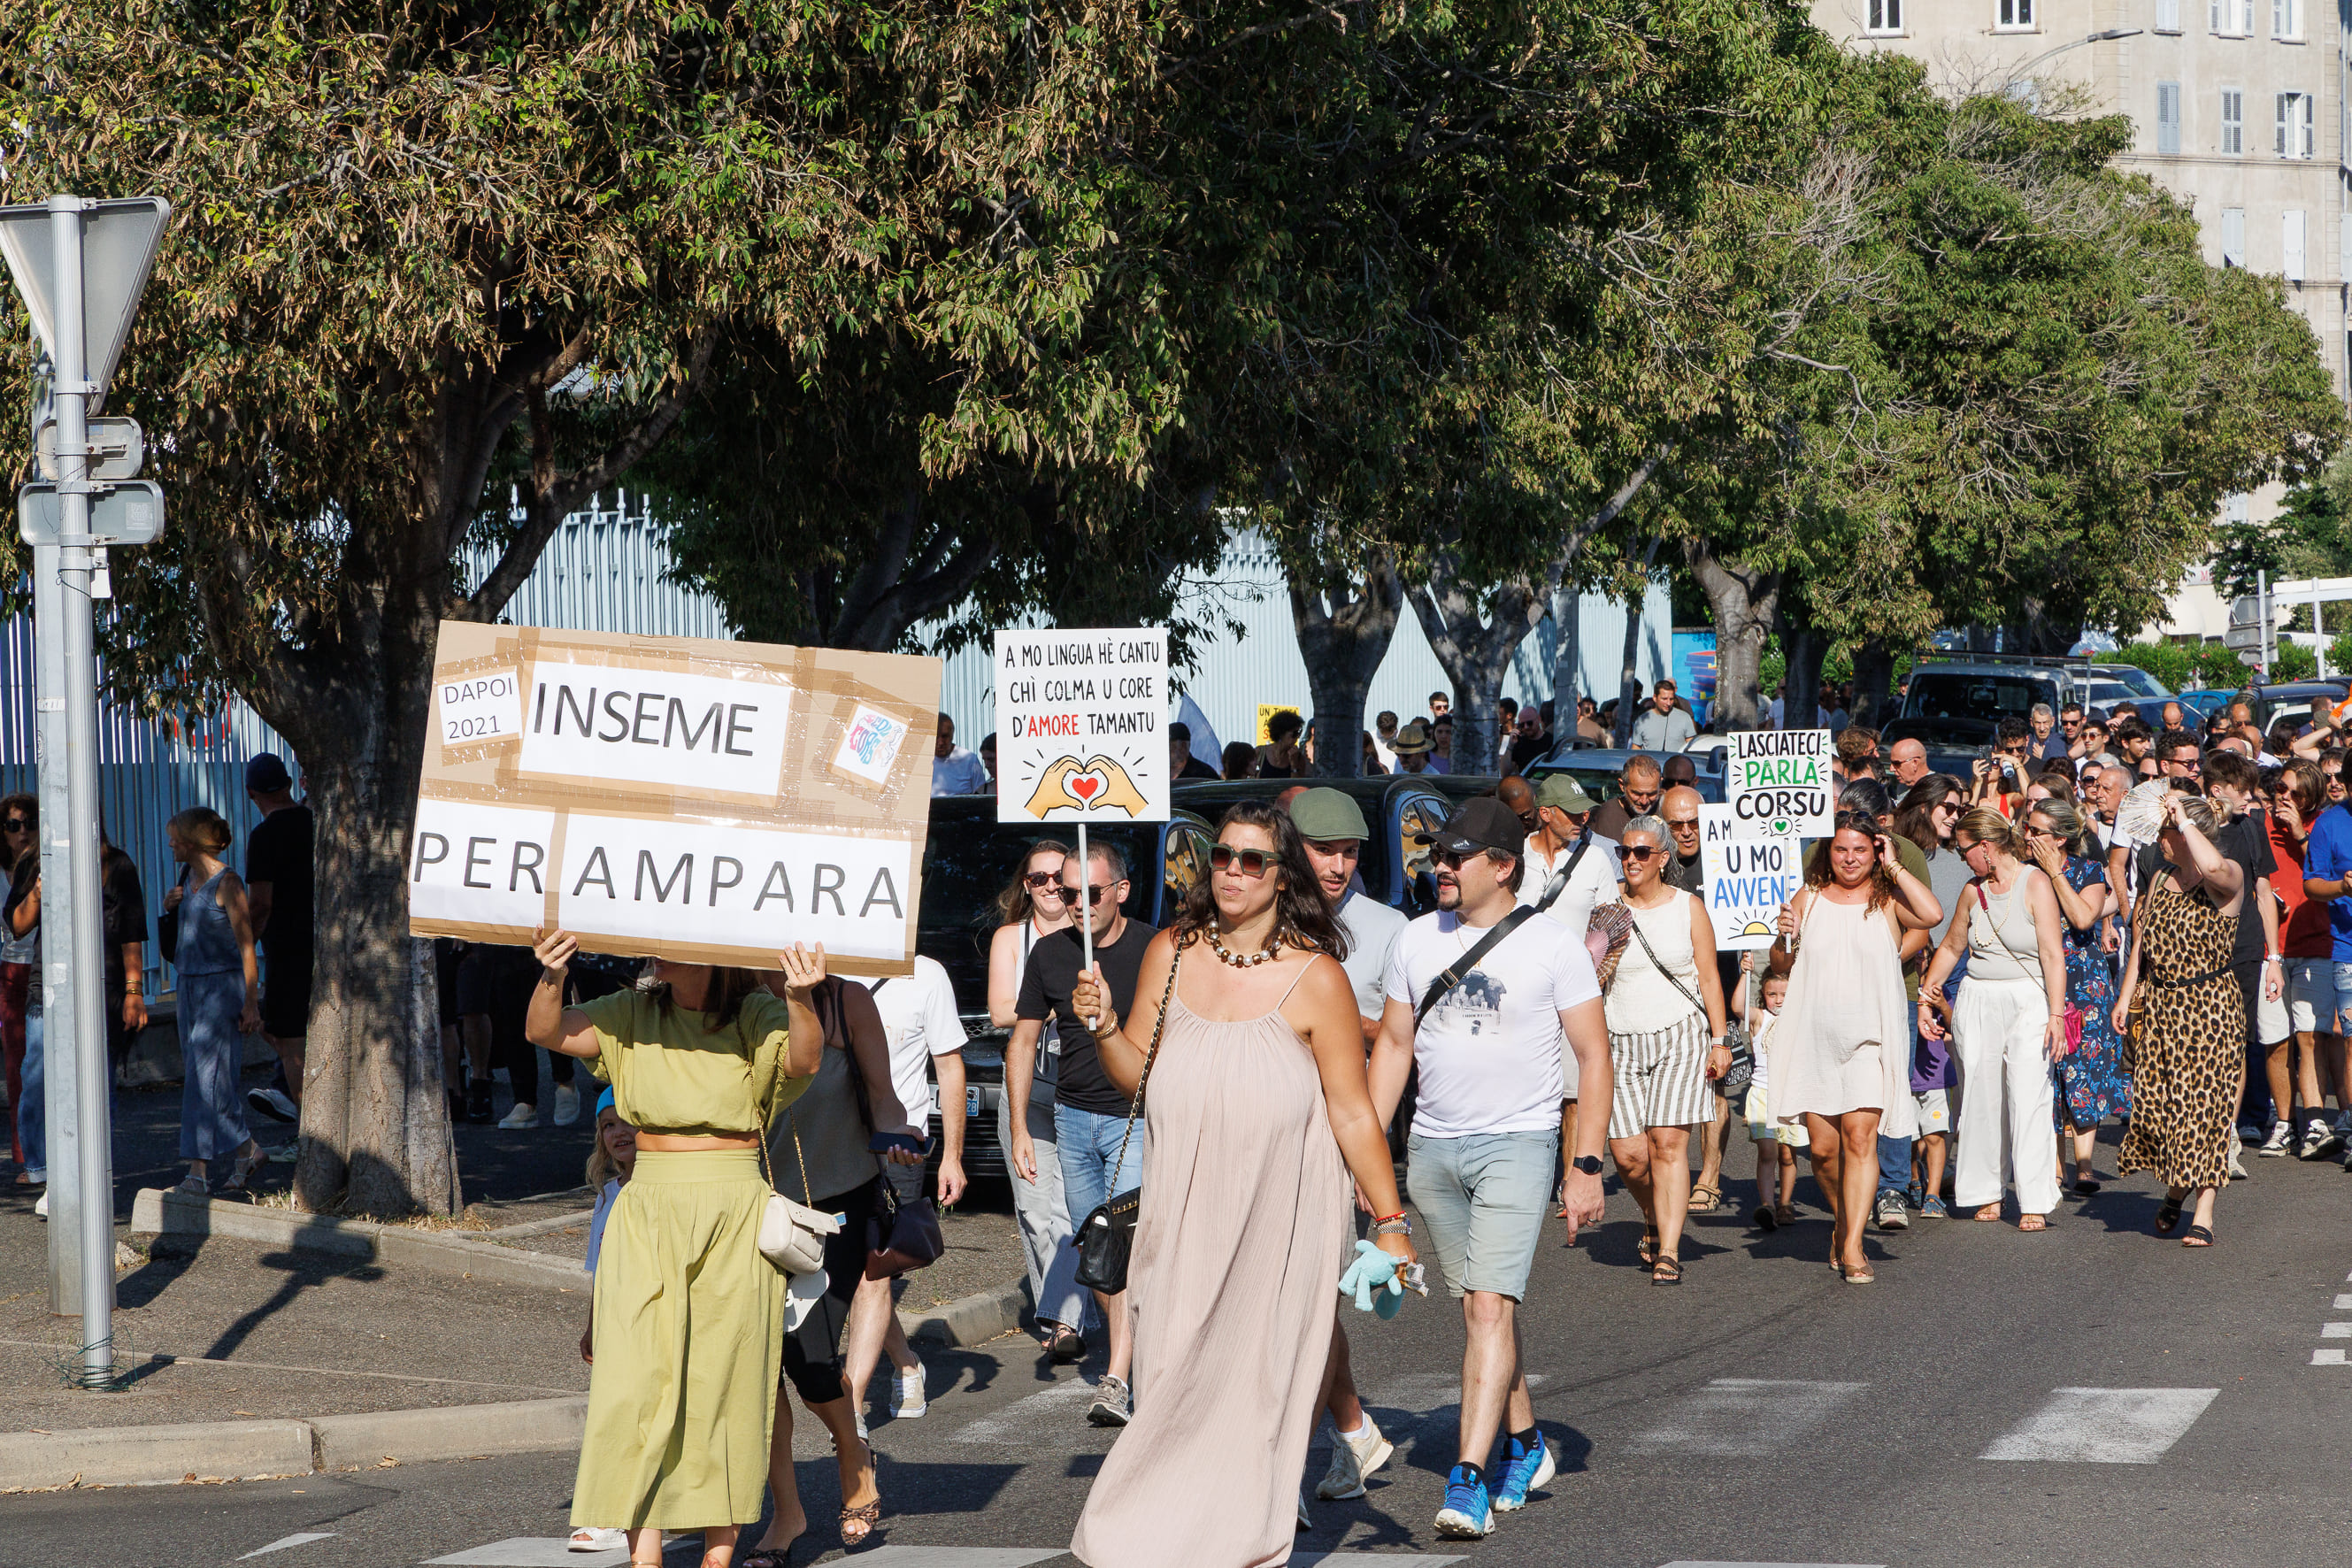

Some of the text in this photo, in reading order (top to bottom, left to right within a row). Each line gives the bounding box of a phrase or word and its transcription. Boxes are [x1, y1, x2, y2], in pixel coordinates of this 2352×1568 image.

[1006, 637, 1158, 668] A MO LINGUA HÈ CANTU
[443, 677, 512, 704] DAPOI
[1010, 676, 1152, 703] CHÌ COLMA U CORE
[449, 716, 499, 738] 2021
[534, 683, 757, 756] INSEME
[1013, 712, 1154, 737] D'AMORE TAMANTU
[1738, 732, 1821, 759] LASCIATECI
[1745, 757, 1818, 788] PARLÀ
[1735, 791, 1825, 820] CORSU
[1708, 820, 1731, 842] A M
[1726, 845, 1781, 873] U MO
[413, 831, 903, 918] PER AMPARA
